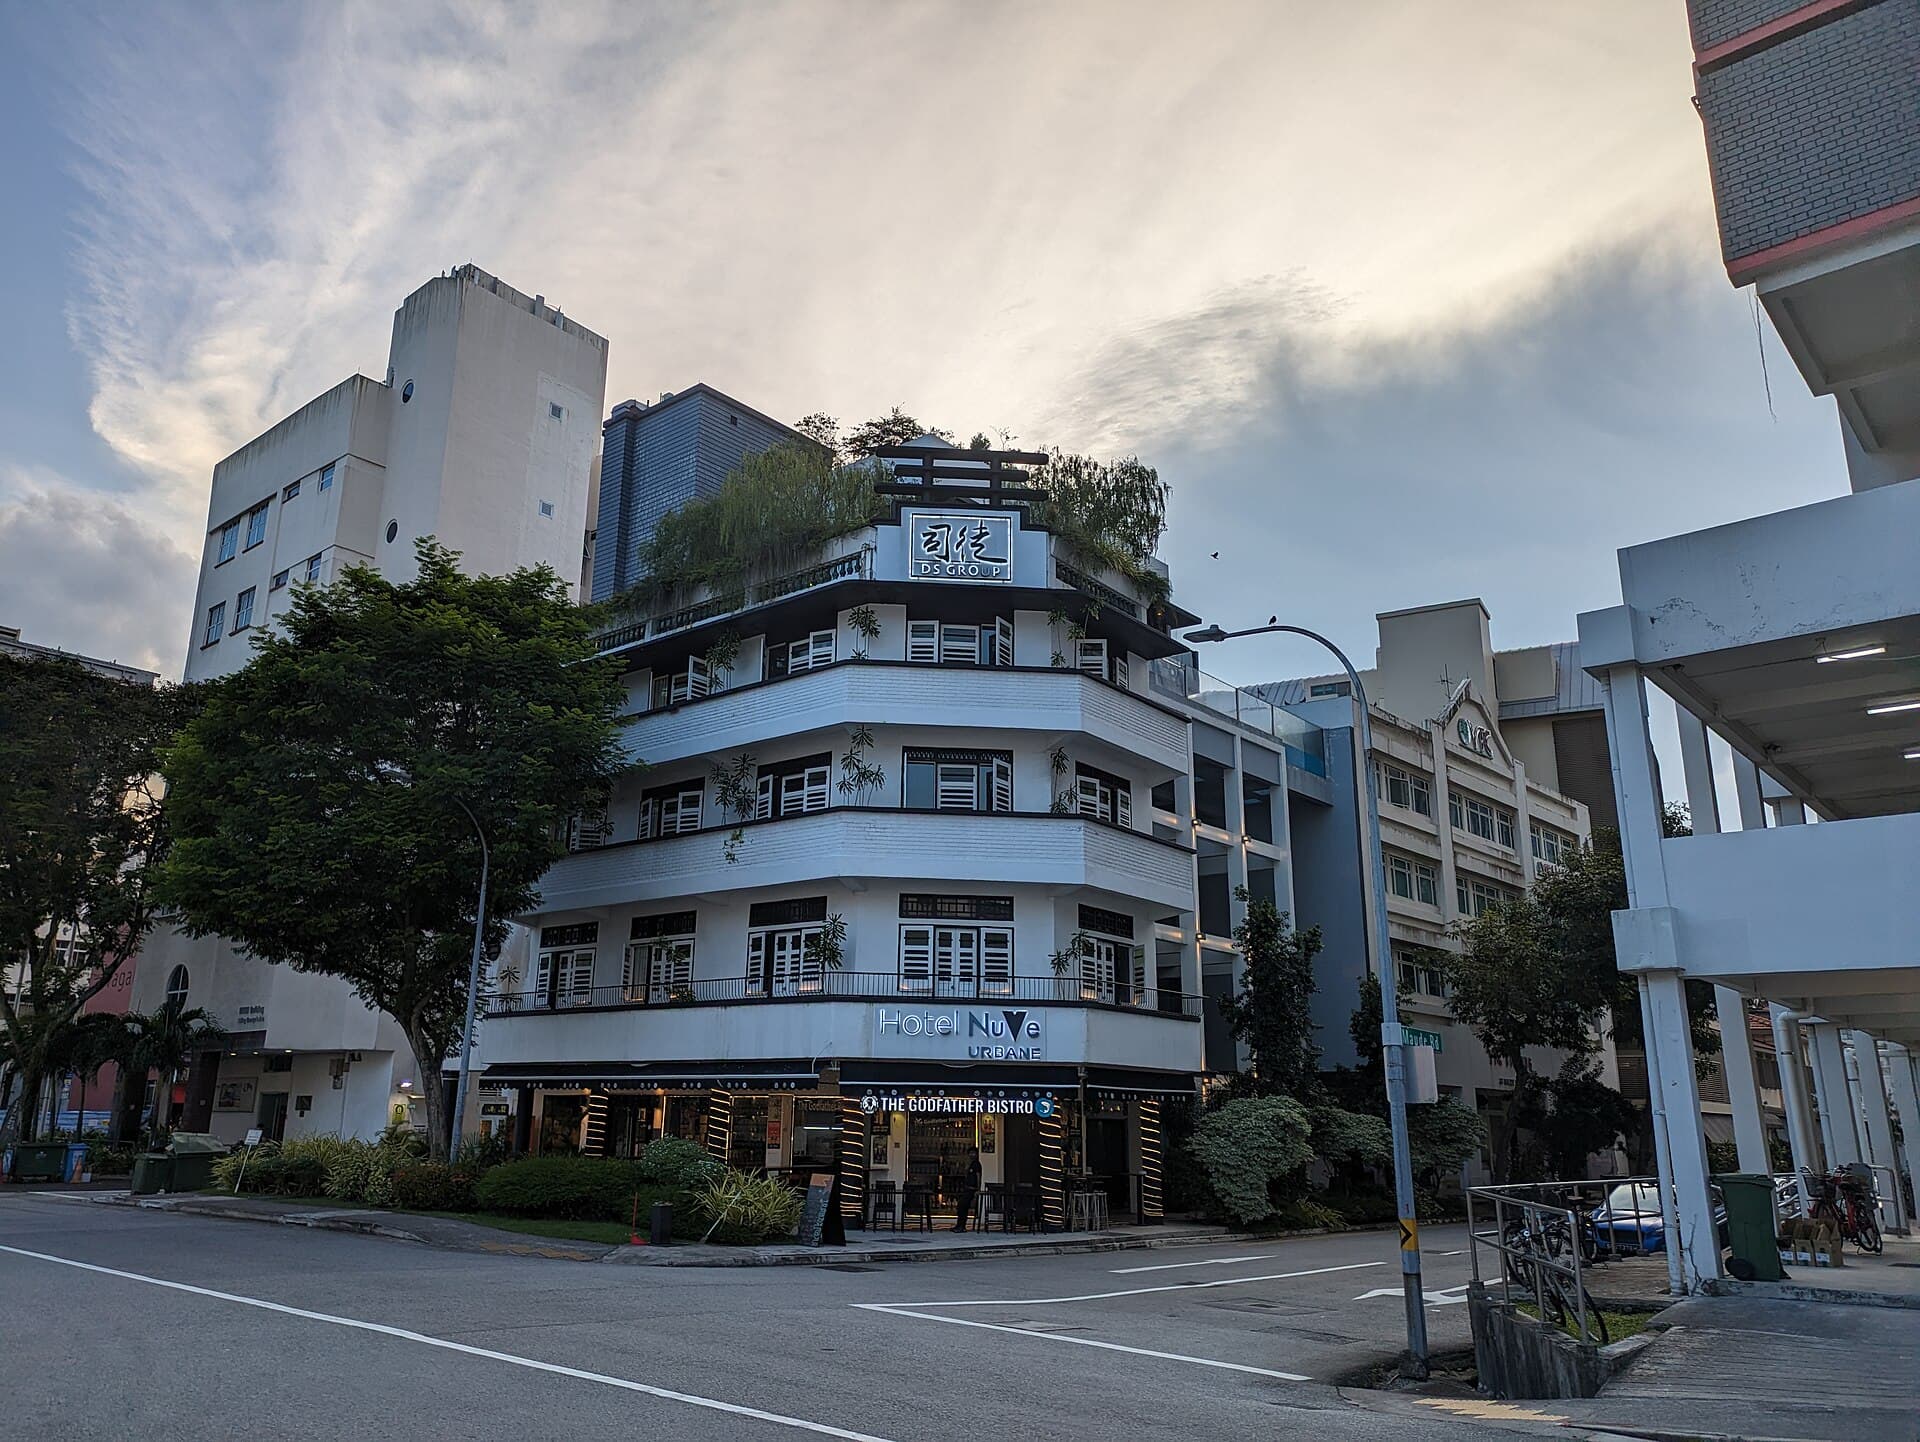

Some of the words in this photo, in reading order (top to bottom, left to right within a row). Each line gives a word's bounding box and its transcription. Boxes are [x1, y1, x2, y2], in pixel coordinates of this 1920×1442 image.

[921, 519, 1008, 562] 司徒
[921, 563, 940, 576] DS
[946, 564, 1000, 577] GROUP
[879, 1008, 959, 1037] Hotel
[1429, 1034, 1440, 1050] Rd
[968, 1046, 1041, 1060] URBANE
[881, 1097, 905, 1112] THE
[908, 1098, 984, 1113] GODFATHER
[987, 1099, 1034, 1115] BISTRO
